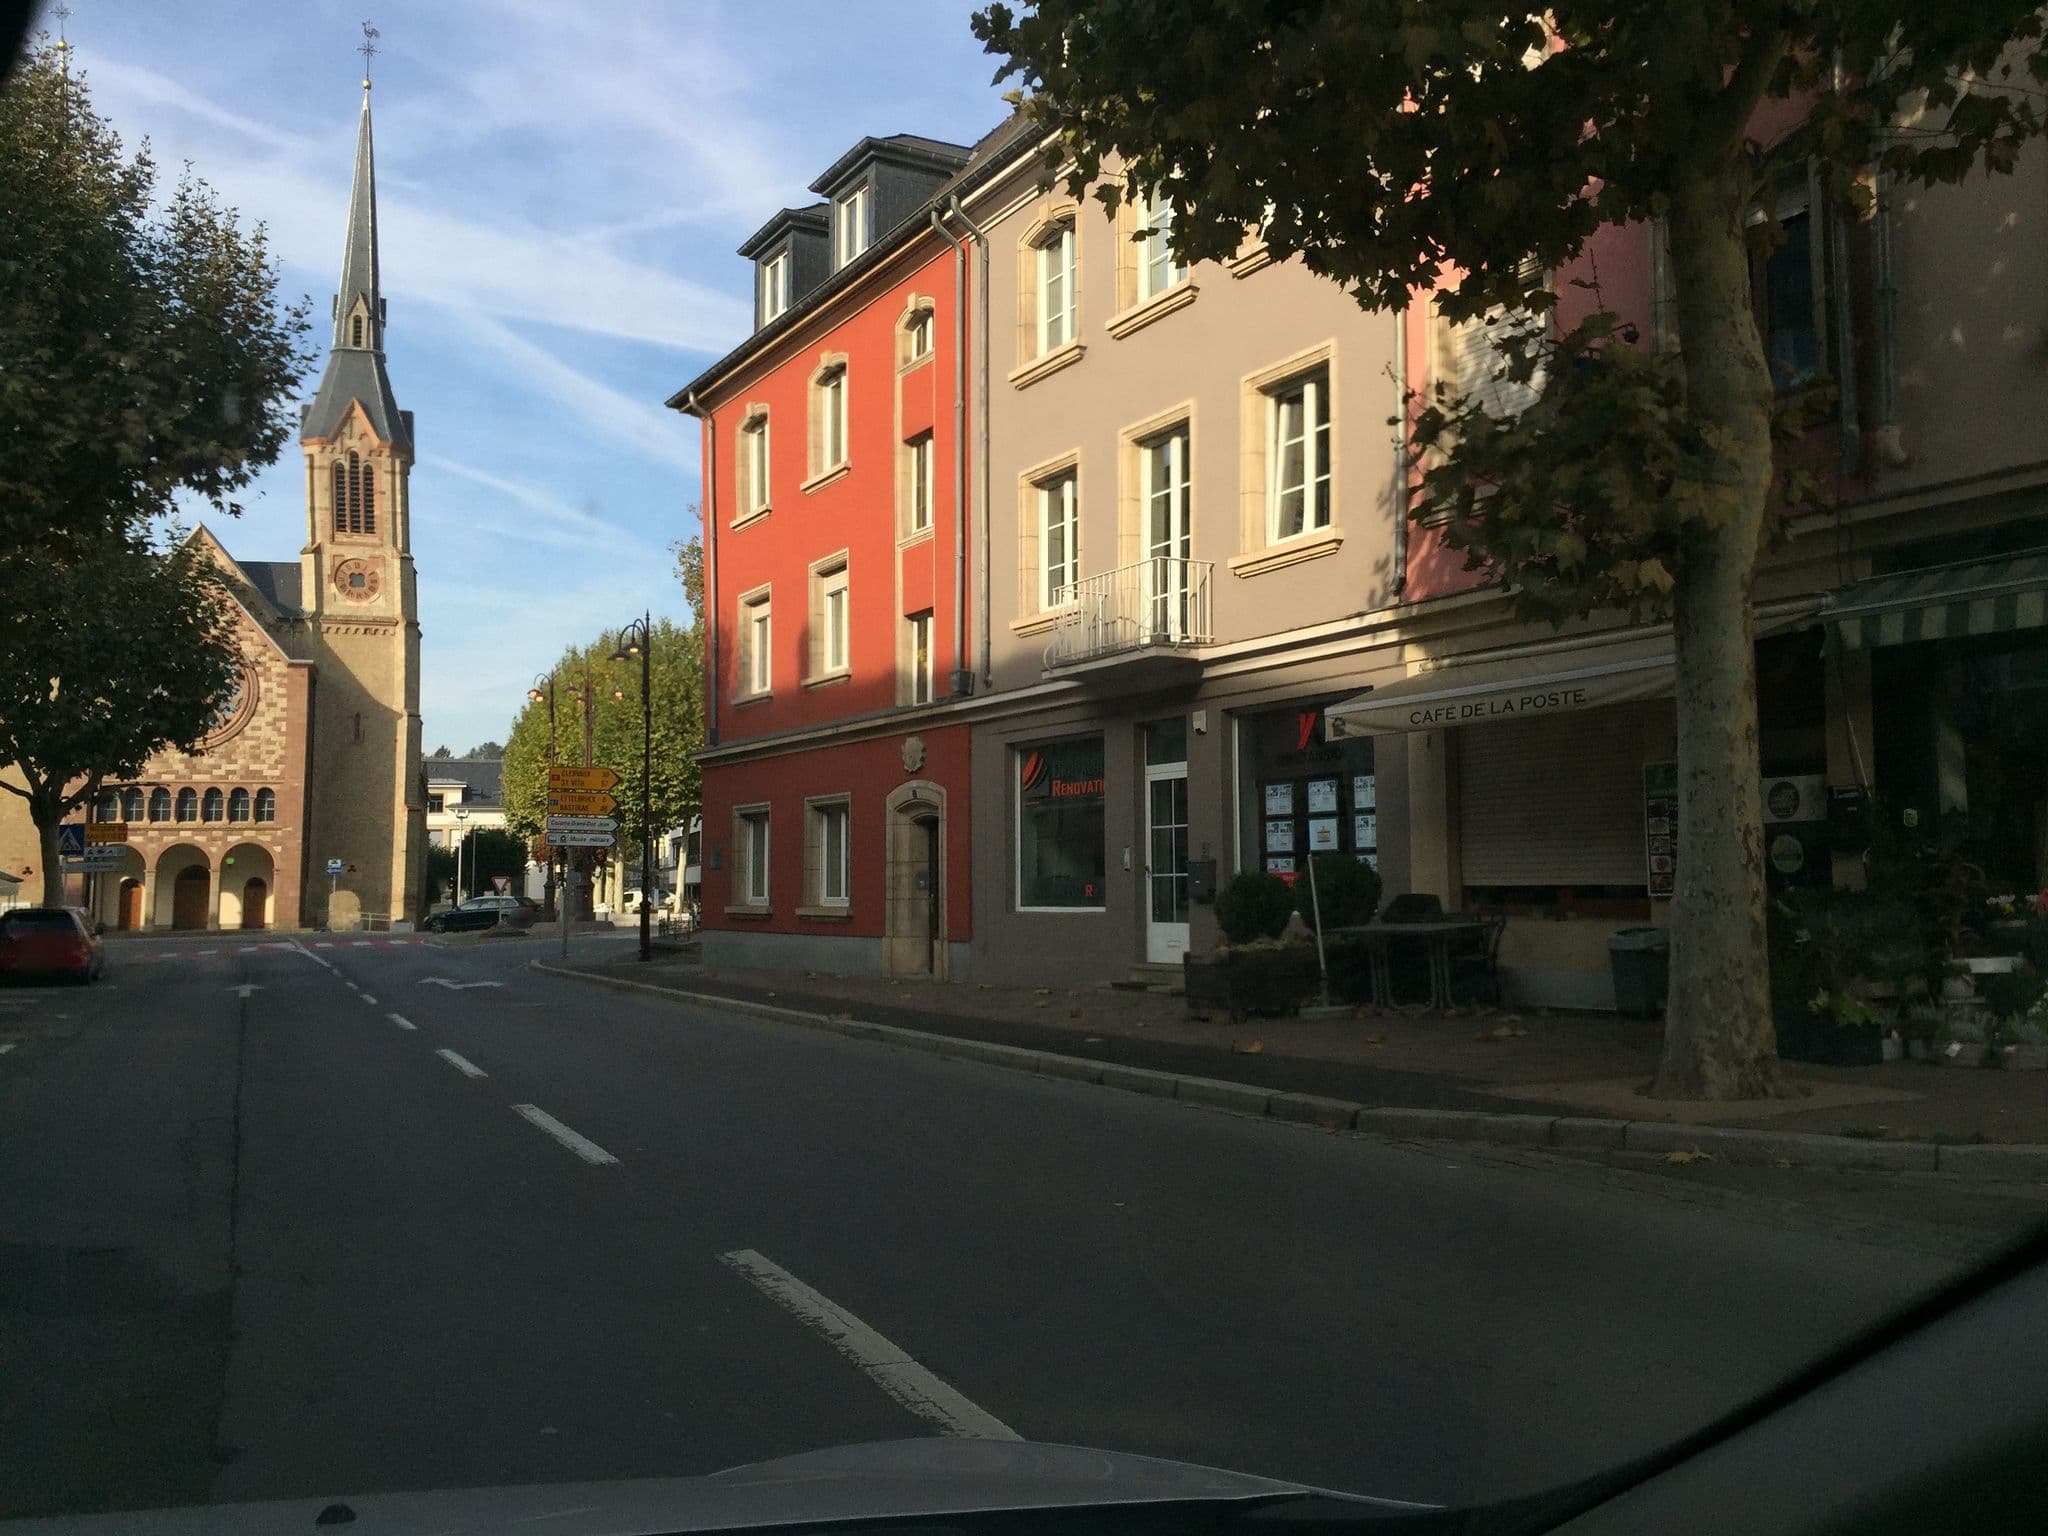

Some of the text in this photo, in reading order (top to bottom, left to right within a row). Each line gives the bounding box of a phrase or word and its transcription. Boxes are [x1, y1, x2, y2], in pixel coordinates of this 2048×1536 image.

[1461, 702, 1486, 719] DE
[1491, 699, 1514, 715] LA
[1519, 688, 1586, 712] POSTE
